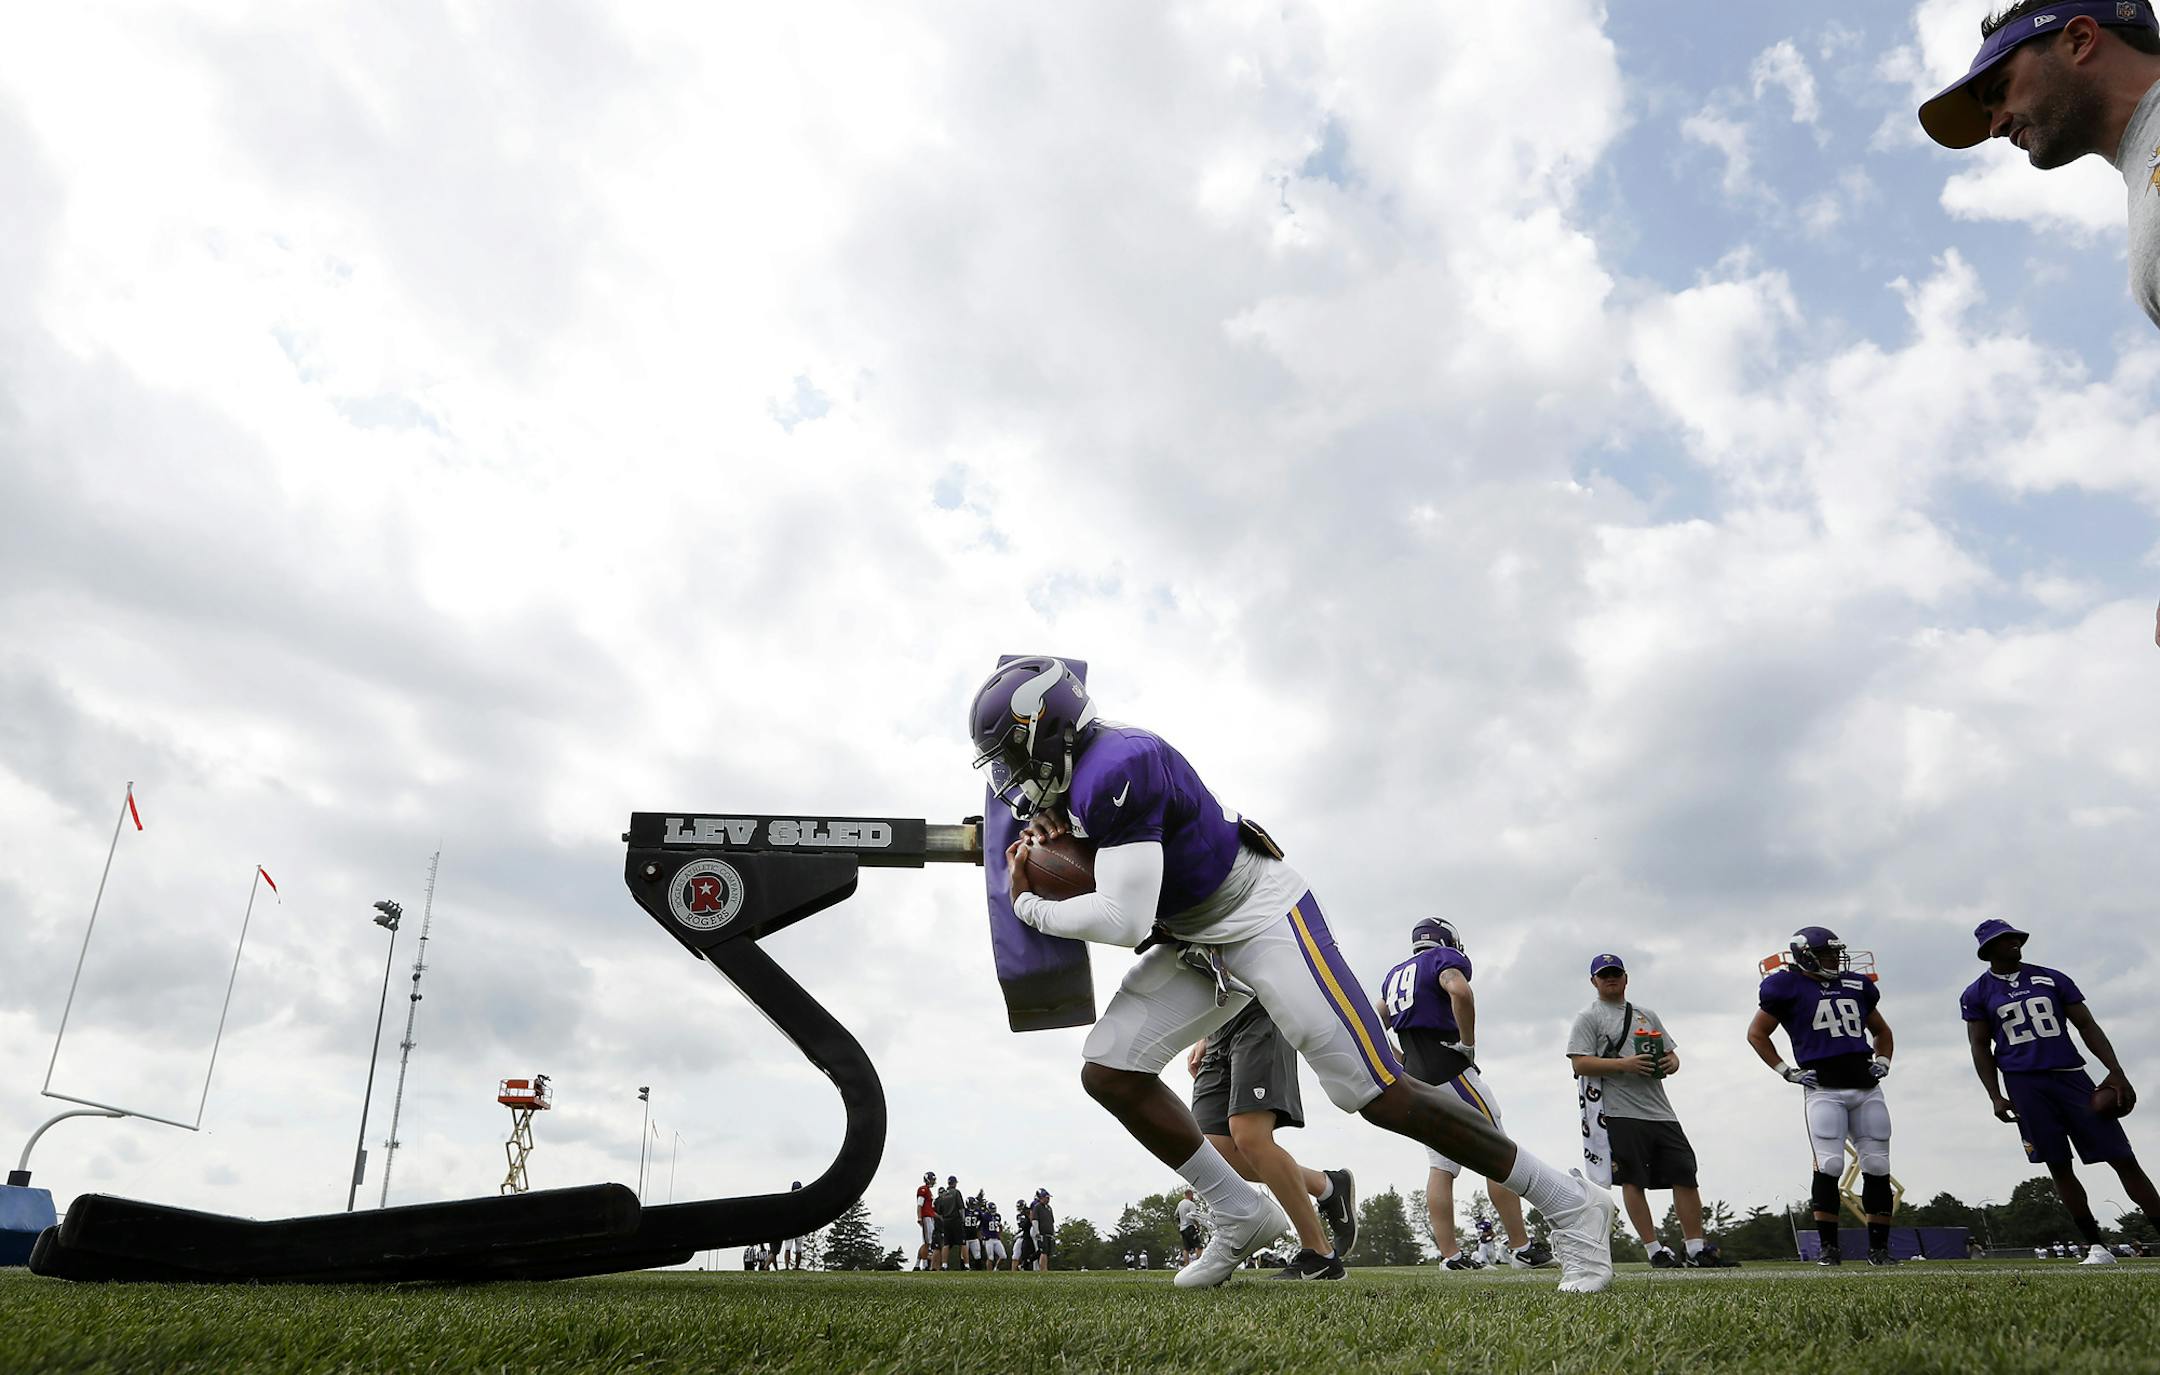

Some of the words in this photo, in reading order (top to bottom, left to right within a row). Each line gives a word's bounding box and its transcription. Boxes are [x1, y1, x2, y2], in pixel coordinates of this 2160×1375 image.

[664, 818, 757, 844] LEV
[768, 820, 892, 847] SLED
[685, 863, 719, 879] ATHLETIC
[720, 868, 739, 904] COMPANY
[690, 875, 724, 913] R
[685, 910, 730, 926] ROGERS
[1386, 963, 1417, 1016] 49
[1812, 998, 1862, 1038] 48
[1997, 996, 2062, 1046] 28
[965, 1216, 977, 1227] 83
